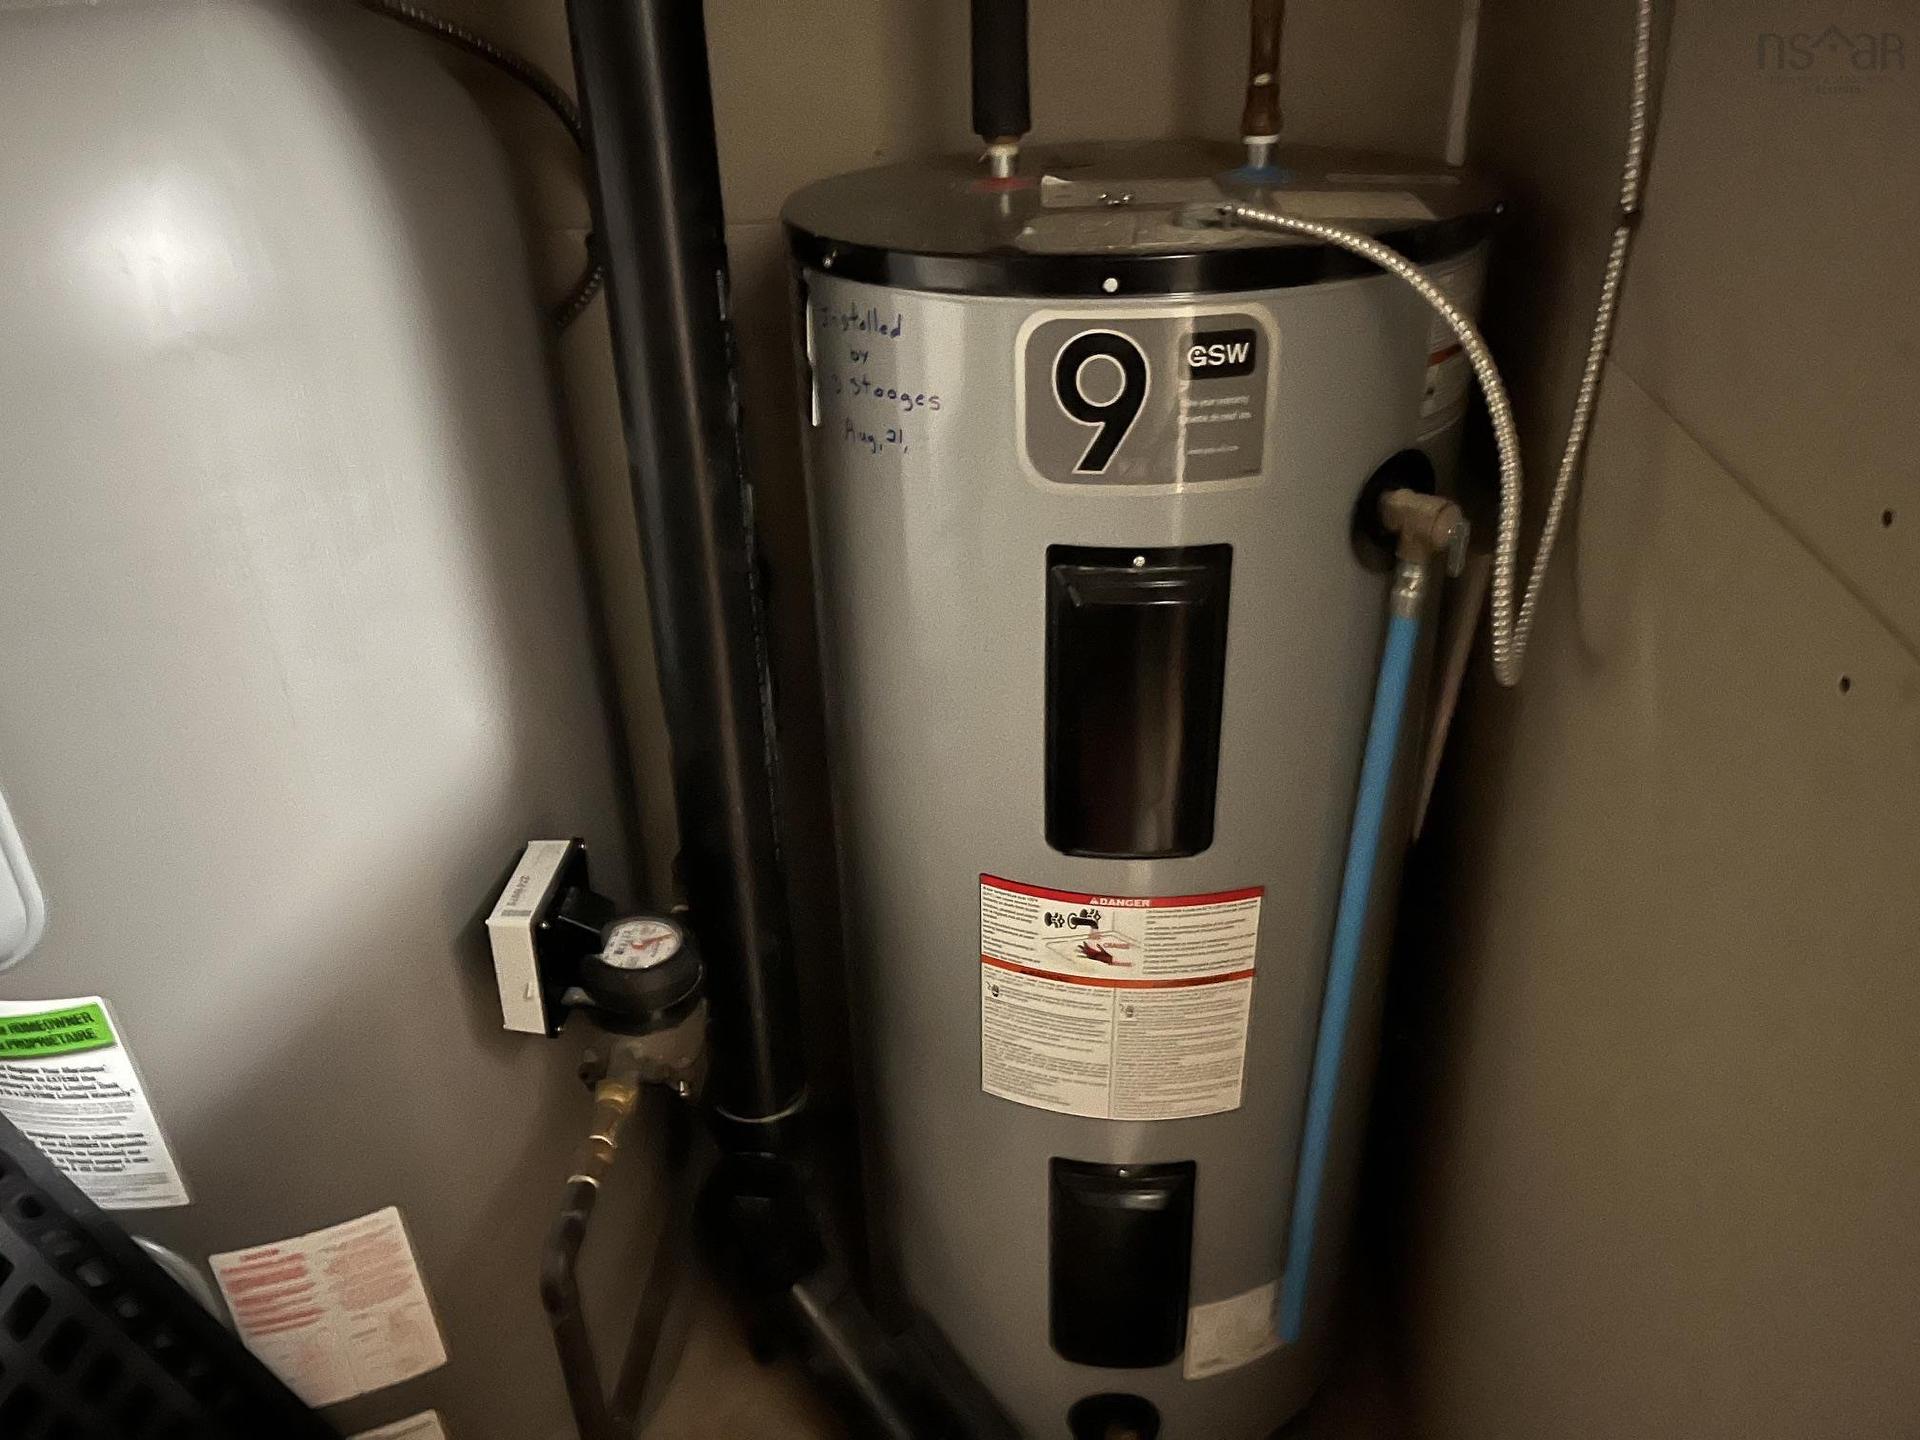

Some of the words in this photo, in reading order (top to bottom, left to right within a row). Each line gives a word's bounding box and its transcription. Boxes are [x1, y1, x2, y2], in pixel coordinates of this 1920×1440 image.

[815, 302, 902, 339] Istalled
[1187, 342, 1249, 367] GSW
[850, 374, 941, 411] stooges
[1052, 328, 1150, 475] 9
[1100, 897, 1151, 907] DANGER
